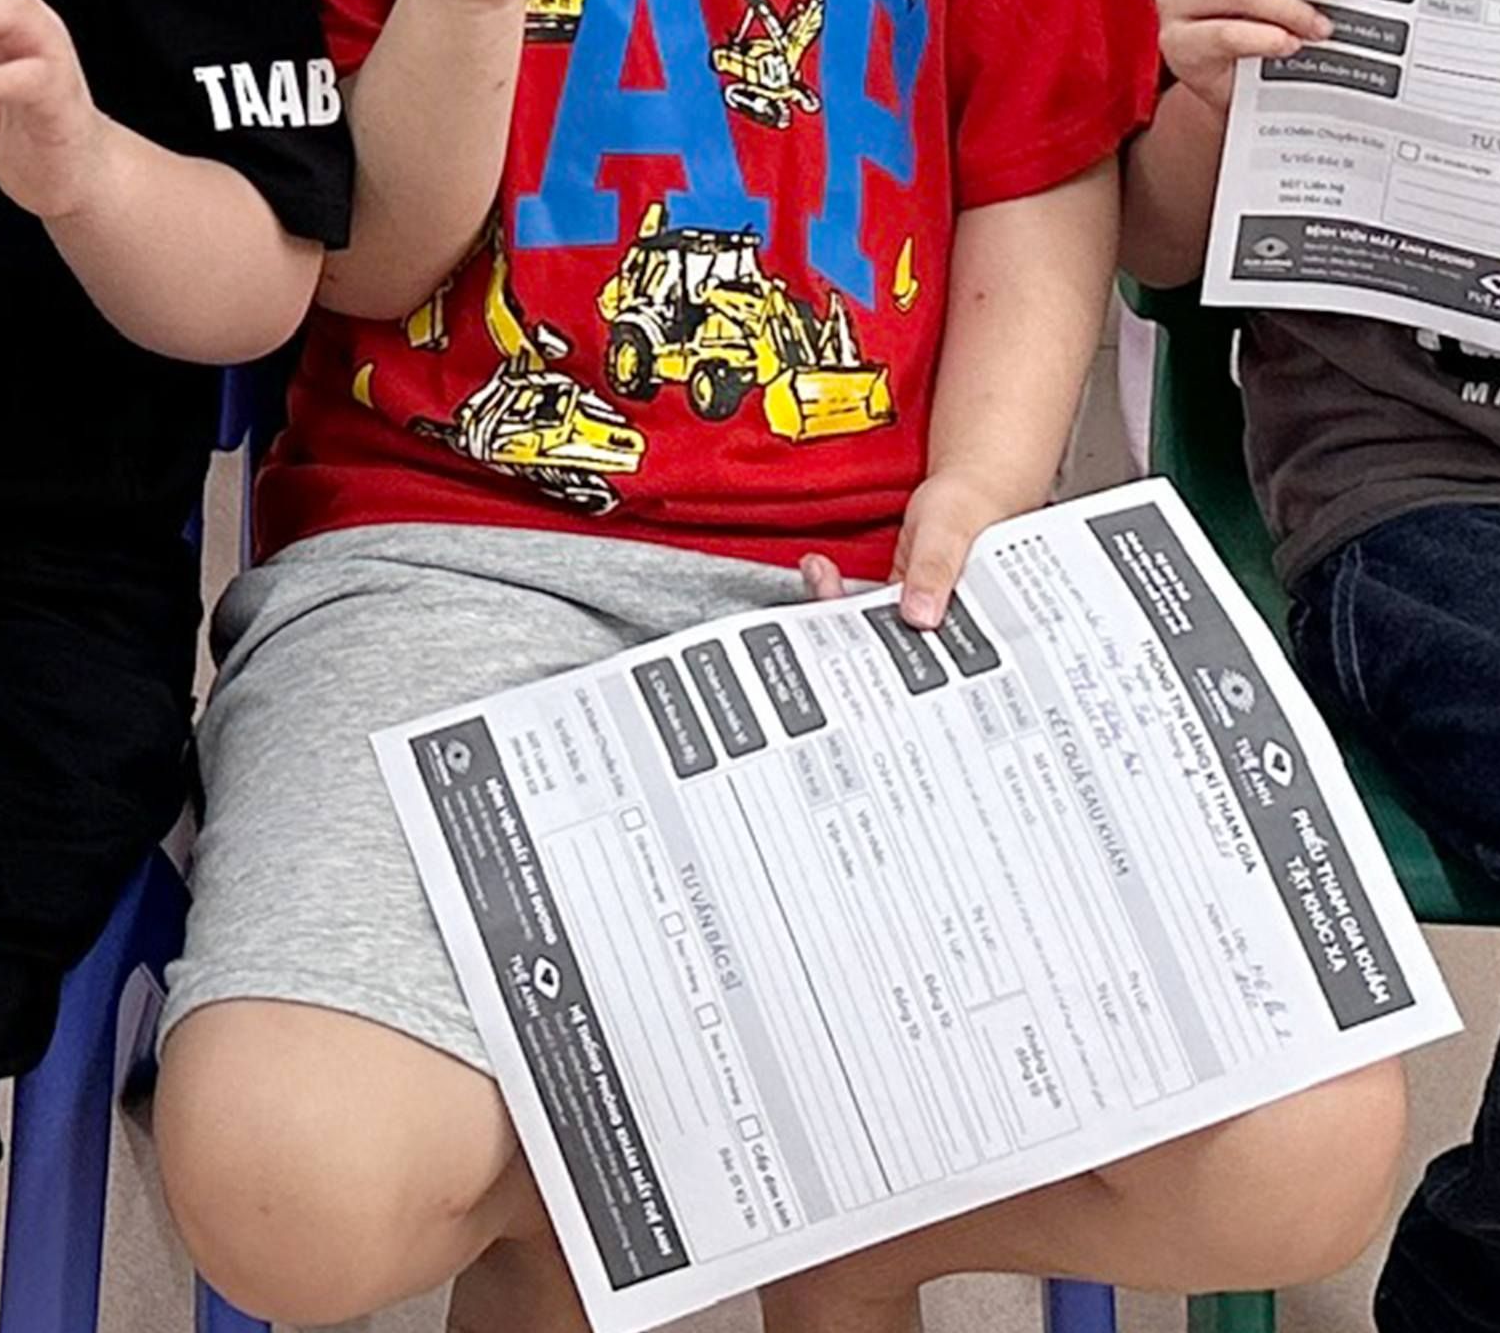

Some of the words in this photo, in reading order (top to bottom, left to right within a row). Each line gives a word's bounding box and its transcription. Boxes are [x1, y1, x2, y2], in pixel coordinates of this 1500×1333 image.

[192, 58, 342, 131] TAAB
[1141, 639, 1177, 691] THÔNG
[1167, 694, 1189, 721] TIN
[1181, 721, 1214, 769] ĐĂNG
[1212, 791, 1246, 840] THAM
[1235, 842, 1260, 873] GIA
[1044, 706, 1069, 739] KẾT
[1077, 783, 1102, 818] SAU
[1093, 819, 1130, 876] KHÁM
[1248, 770, 1275, 806] ANH
[1290, 807, 1330, 861] PHIẾU
[1313, 863, 1352, 916] THAM
[704, 927, 733, 969] BÁC
[1339, 916, 1365, 948] GIA
[1351, 947, 1393, 1003] KHÁM
